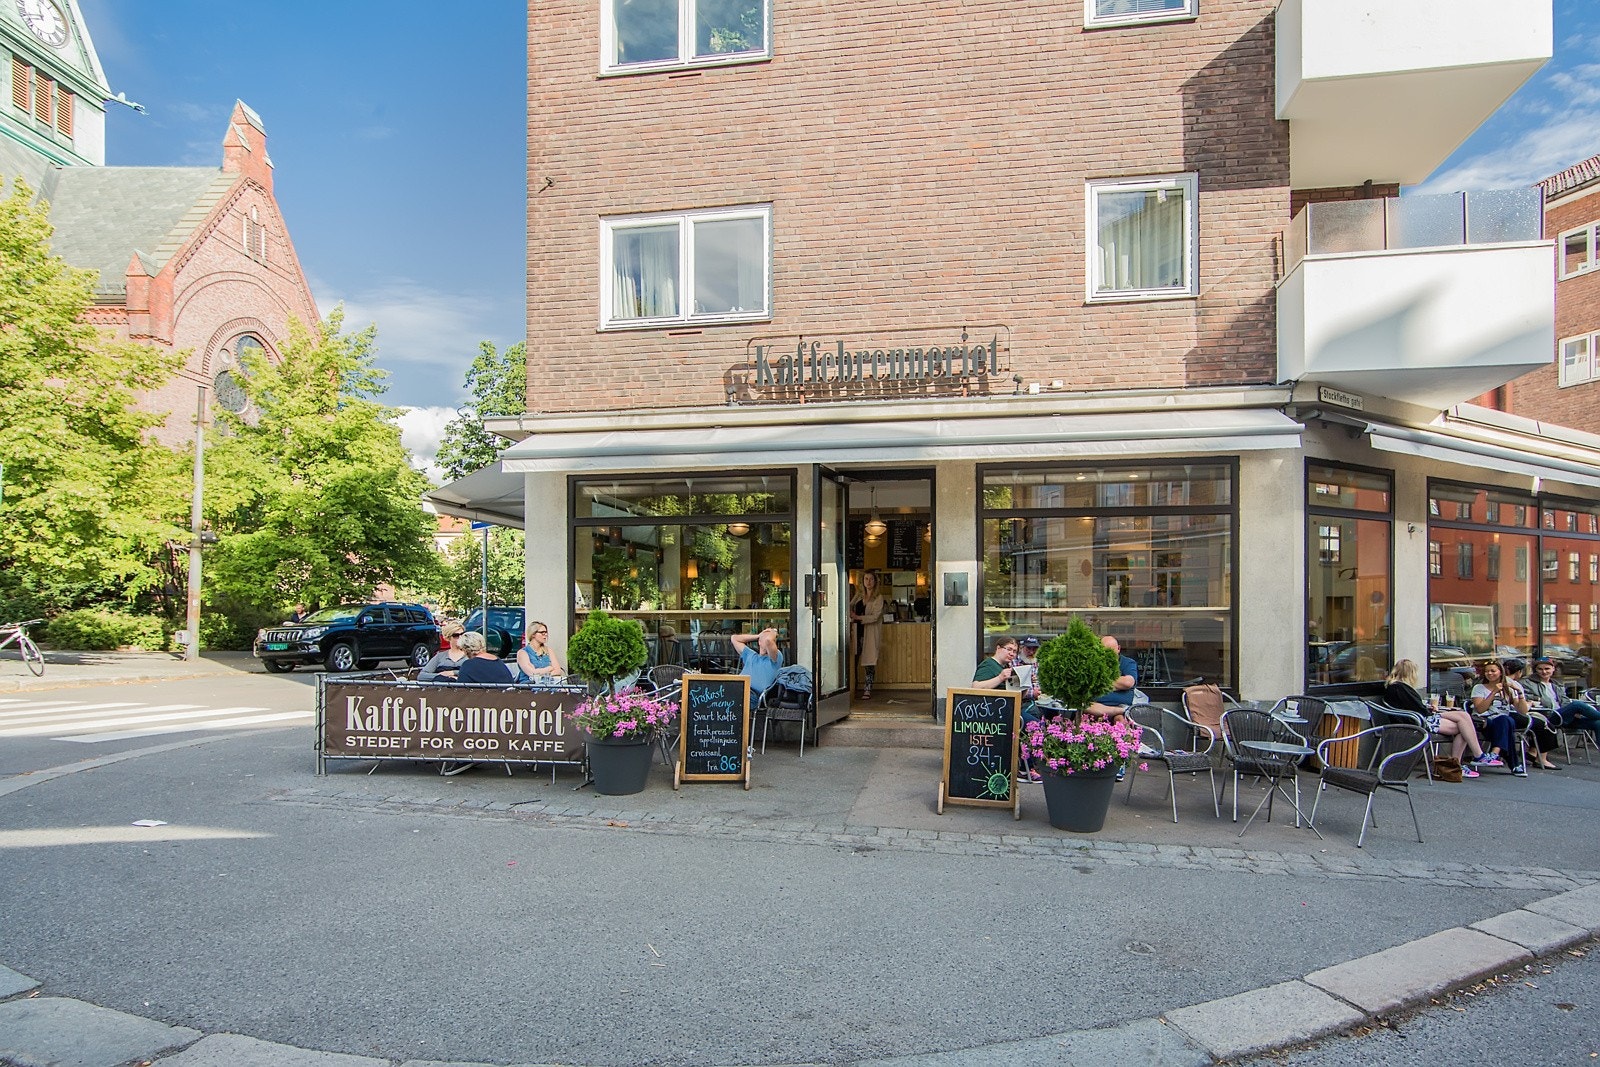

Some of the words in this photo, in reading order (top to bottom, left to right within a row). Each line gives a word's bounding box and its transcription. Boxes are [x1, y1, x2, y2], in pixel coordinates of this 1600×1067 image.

[755, 333, 1001, 386] Kaffebrenneriet
[345, 695, 566, 736] Kaffebrenneriet
[693, 711, 714, 721] Svart
[716, 711, 737, 722] kaffe
[954, 722, 1007, 735] LIMONADE
[346, 735, 411, 749] STEDET
[420, 737, 454, 749] FOR
[463, 738, 499, 751] GOD
[508, 740, 565, 753] KAFFE
[970, 735, 994, 746] ISTE
